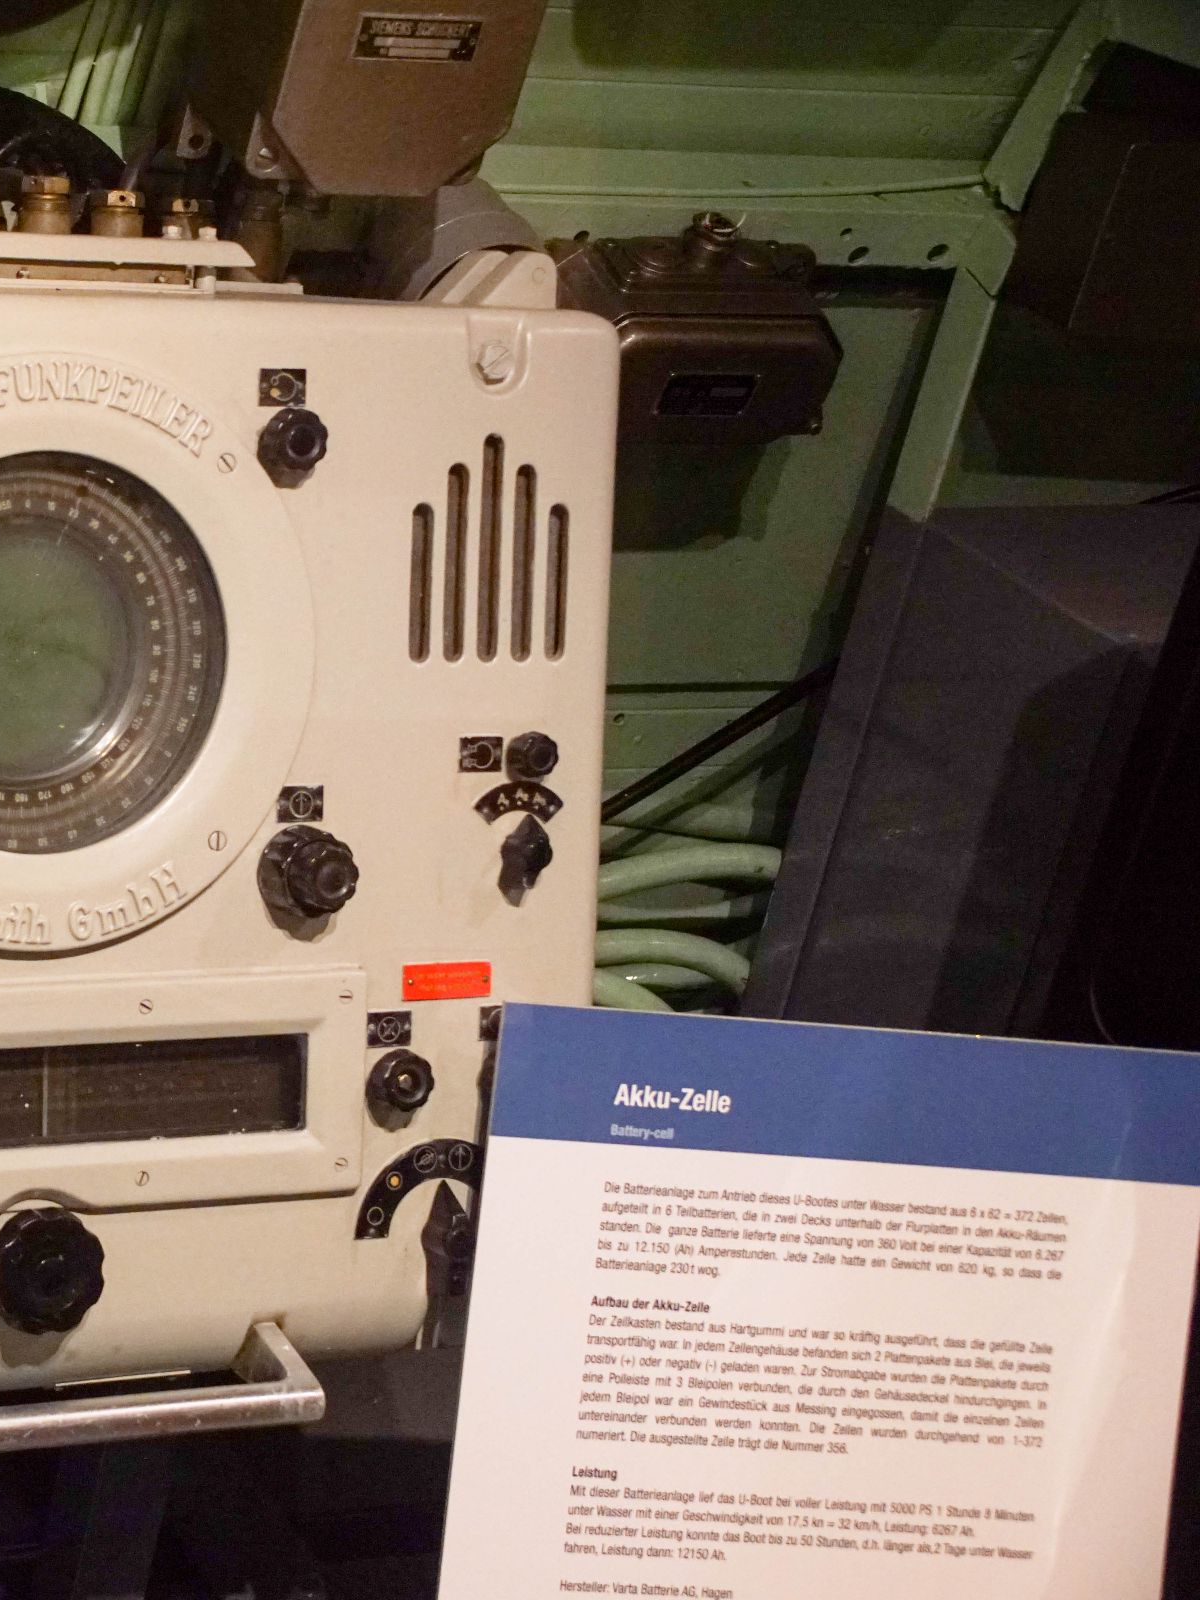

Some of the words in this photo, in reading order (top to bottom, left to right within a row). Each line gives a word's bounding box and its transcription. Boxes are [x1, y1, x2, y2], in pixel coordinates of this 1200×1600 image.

[67, 860, 188, 941] GmbH
[613, 1083, 732, 1114] Akku-Zelle
[610, 1123, 675, 1140] Battery-cell
[604, 1181, 621, 1194] Die
[623, 1183, 695, 1201] Batterieanlage
[698, 1191, 719, 1200] zum
[721, 1189, 757, 1203] Antrieb
[759, 1192, 791, 1205] dieses
[793, 1194, 839, 1208] U-Bootes
[601, 1200, 649, 1217] aufgeteilt
[652, 1204, 662, 1216] in
[665, 1205, 673, 1216] 6
[675, 1205, 739, 1222] Teilbatterien,
[742, 1210, 758, 1222] die
[761, 1211, 771, 1223] in
[599, 1219, 641, 1233] standen.
[645, 1222, 662, 1235] Die
[667, 1226, 698, 1239] ganze
[700, 1226, 740, 1240] Batterie
[742, 1229, 777, 1242] lieferte
[597, 1238, 613, 1250] bis
[617, 1242, 630, 1251] zu
[674, 1243, 695, 1258] (Ah)
[697, 1245, 779, 1263] Amperestunden.
[594, 1257, 668, 1275] Batterieanlage
[591, 1295, 630, 1308] Aufbau
[632, 1297, 650, 1310] der
[652, 1299, 711, 1313] Akku-Zelle
[588, 1314, 606, 1326] Der
[610, 1315, 661, 1329] Zellkasten
[665, 1318, 705, 1332] bestand
[708, 1324, 726, 1333] aus
[729, 1322, 785, 1340] Hartgummi
[586, 1333, 656, 1351] transportfähig
[659, 1340, 680, 1349] war.
[682, 1338, 692, 1350] In
[694, 1339, 725, 1355] jedem
[583, 1351, 617, 1367] positiv
[639, 1355, 662, 1367] oder
[665, 1356, 702, 1372] negativ
[720, 1360, 760, 1376] geladen
[582, 1370, 604, 1383] eine
[608, 1372, 650, 1386] Polleiste
[655, 1375, 672, 1387] mit
[676, 1376, 683, 1388] 3
[687, 1377, 733, 1393] Bleipolen
[580, 1389, 611, 1405] jedem
[616, 1392, 650, 1407] Bleipol
[654, 1397, 673, 1406] war
[678, 1395, 694, 1407] ein
[698, 1396, 768, 1412] Gewindestück
[578, 1408, 648, 1424] untereinander
[654, 1413, 708, 1427] verbunden
[714, 1416, 752, 1430] werden
[575, 1427, 627, 1442] numeriert.
[629, 1431, 647, 1443] Die
[648, 1432, 709, 1449] ausgestellte
[711, 1435, 735, 1448] Zelle
[737, 1437, 761, 1452] trägt
[763, 1438, 779, 1450] die
[781, 1439, 824, 1453] Nummer
[571, 1465, 618, 1482] Leistung
[569, 1484, 587, 1497] Mit
[589, 1486, 620, 1499] dieser
[623, 1487, 696, 1505] Batterieanlage
[698, 1492, 715, 1504] lief
[716, 1493, 736, 1505] das
[738, 1494, 774, 1507] U-Boot
[567, 1503, 595, 1516] unter
[596, 1505, 633, 1518] Wasser
[636, 1507, 652, 1519] mit
[654, 1508, 680, 1521] einer
[682, 1510, 763, 1528] Geschwindigkeit
[765, 1517, 784, 1527] von
[565, 1523, 582, 1535] Bei
[584, 1524, 638, 1538] reduzierter
[641, 1527, 684, 1543] Leistung
[686, 1529, 720, 1542] konnte
[722, 1531, 741, 1543] das
[743, 1532, 766, 1545] Boot
[768, 1533, 784, 1546] bis
[563, 1542, 598, 1556] fahren,
[601, 1544, 644, 1560] Leistung
[646, 1546, 673, 1559] dann:
[678, 1548, 709, 1561] 12150
[711, 1549, 726, 1562] Ah.
[559, 1580, 609, 1594] Hersteller:
[612, 1582, 638, 1595] Varta
[641, 1584, 679, 1597] Batterie
[681, 1586, 699, 1600] AG,
[701, 1587, 733, 1600] Hagen
